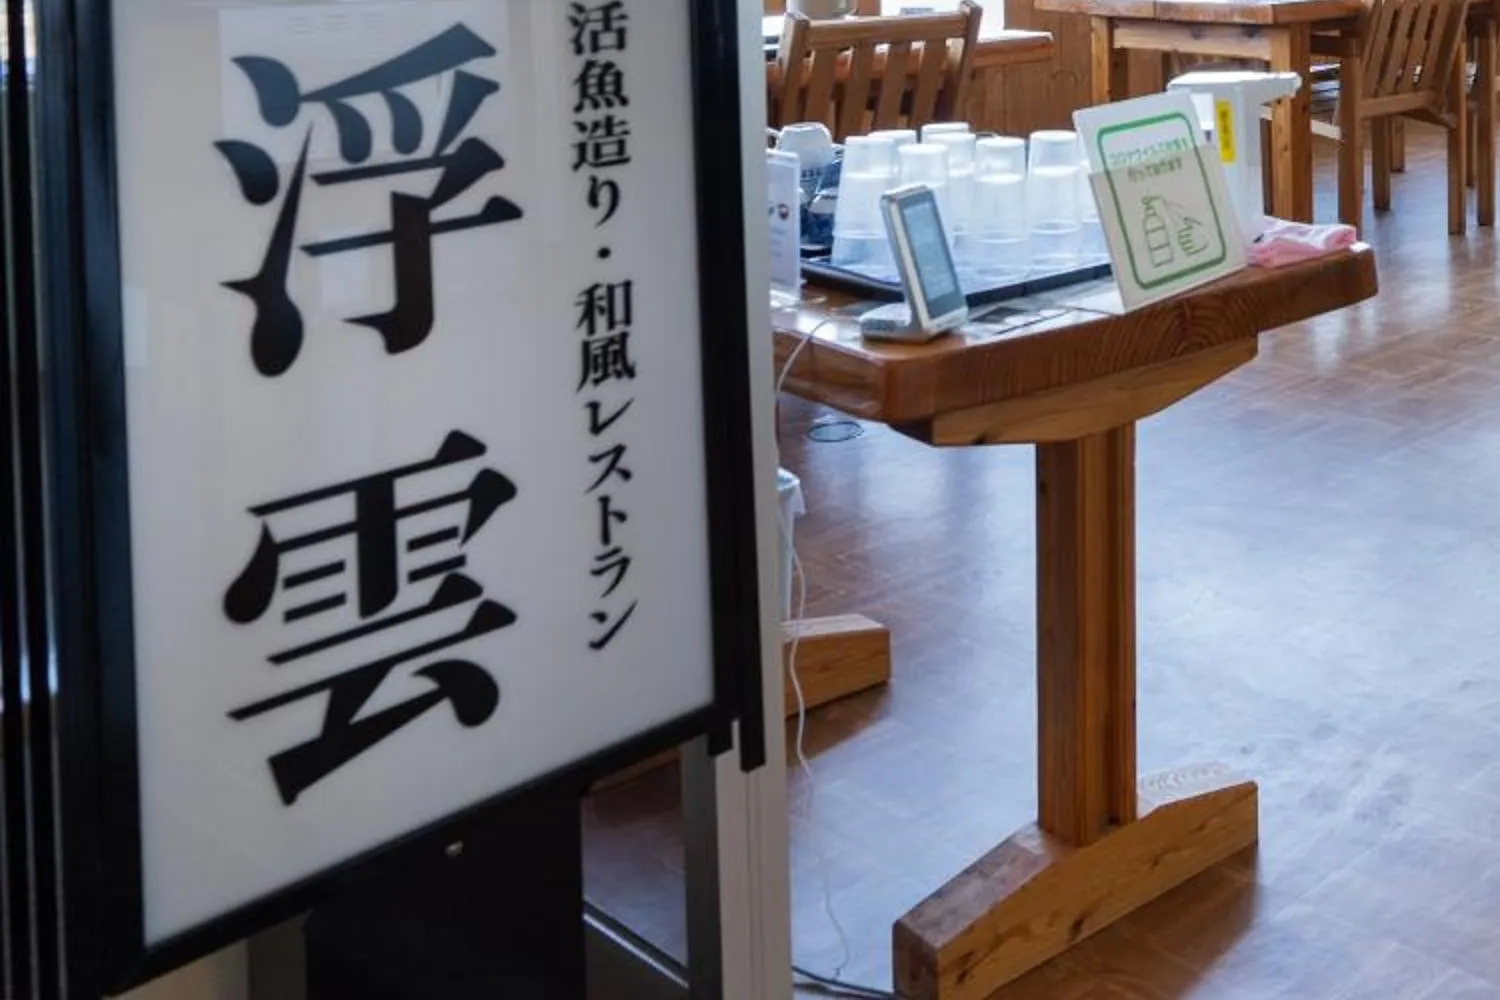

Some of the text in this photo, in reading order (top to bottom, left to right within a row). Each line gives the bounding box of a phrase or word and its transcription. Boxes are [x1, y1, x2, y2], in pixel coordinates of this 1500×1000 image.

[213, 22, 524, 806] 浮雲
[567, 0, 639, 651] 活魚造り・和風レストラン
